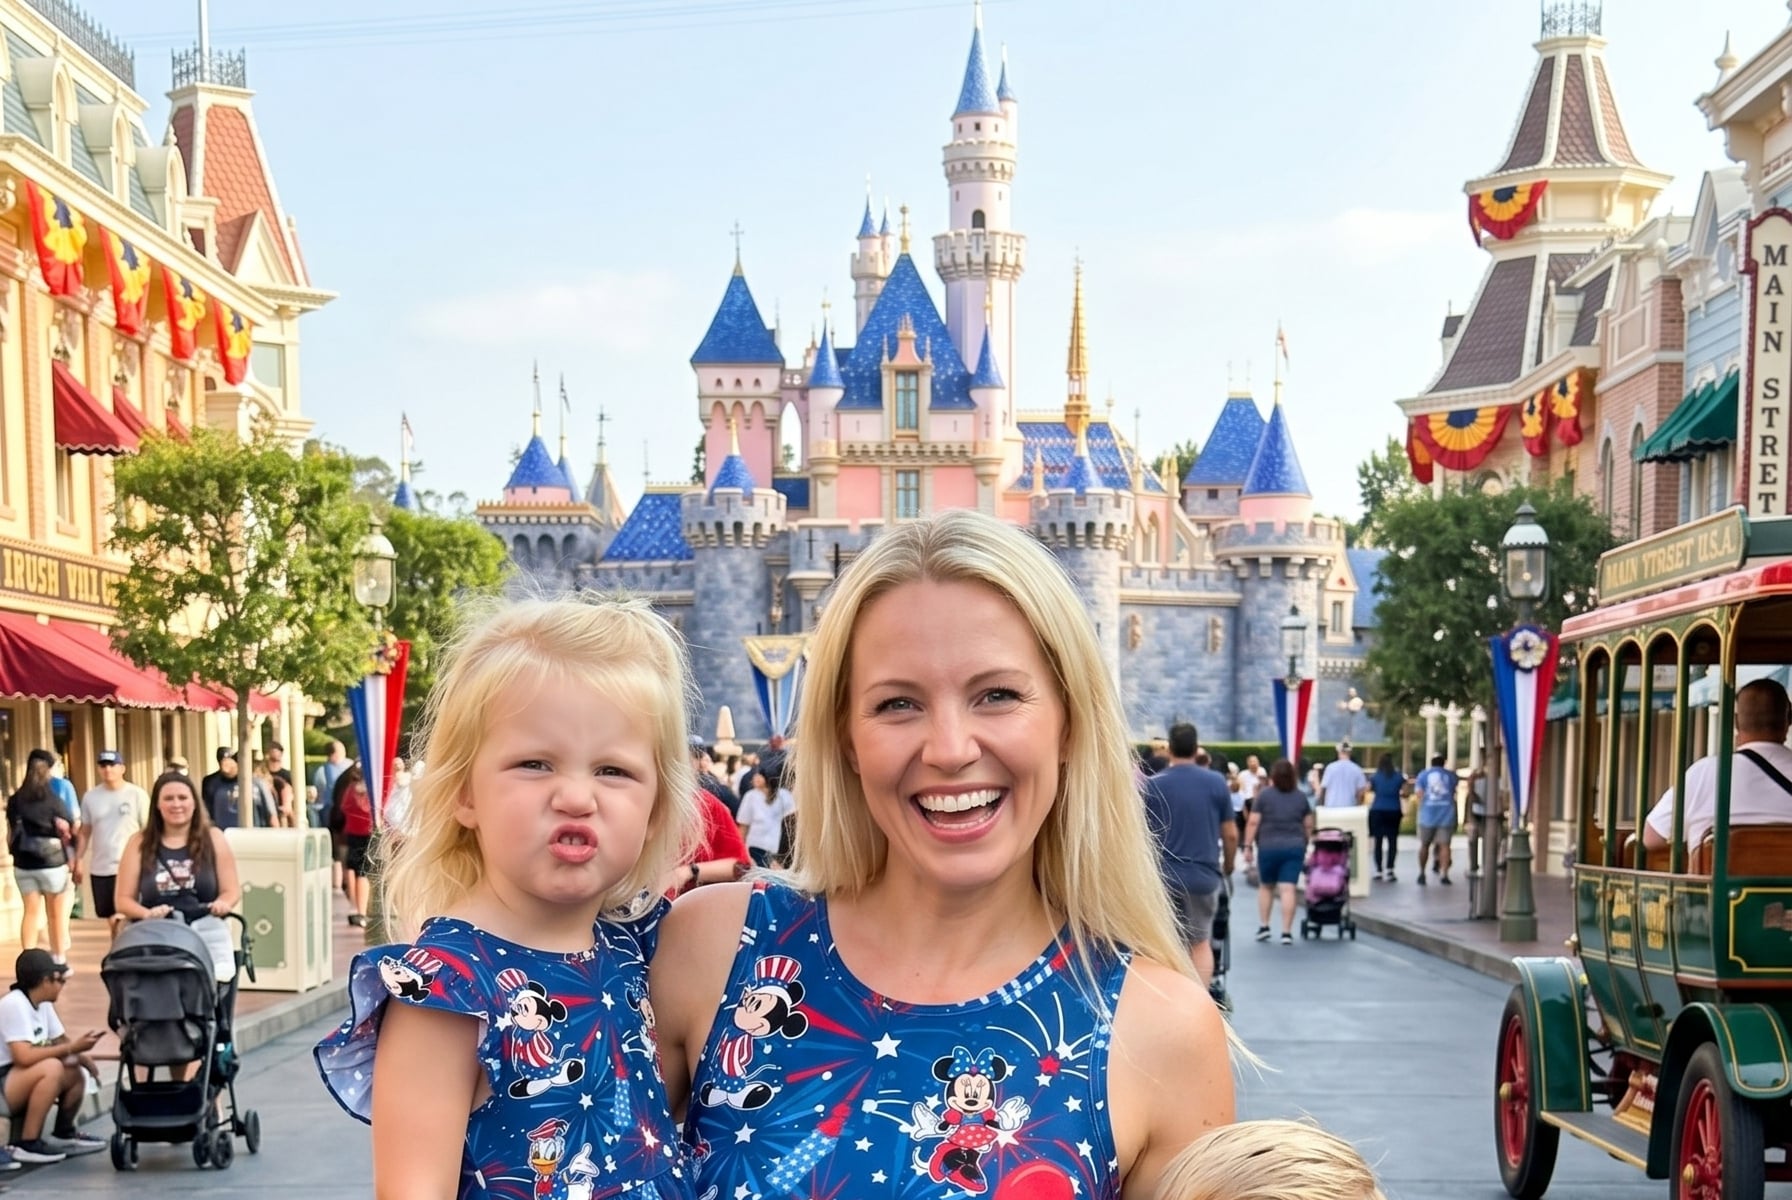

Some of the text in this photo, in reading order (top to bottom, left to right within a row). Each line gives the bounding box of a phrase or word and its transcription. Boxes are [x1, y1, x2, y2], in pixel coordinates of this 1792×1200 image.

[1758, 244, 1788, 513] MAIN STRET
[3, 548, 60, 597] IRUSH
